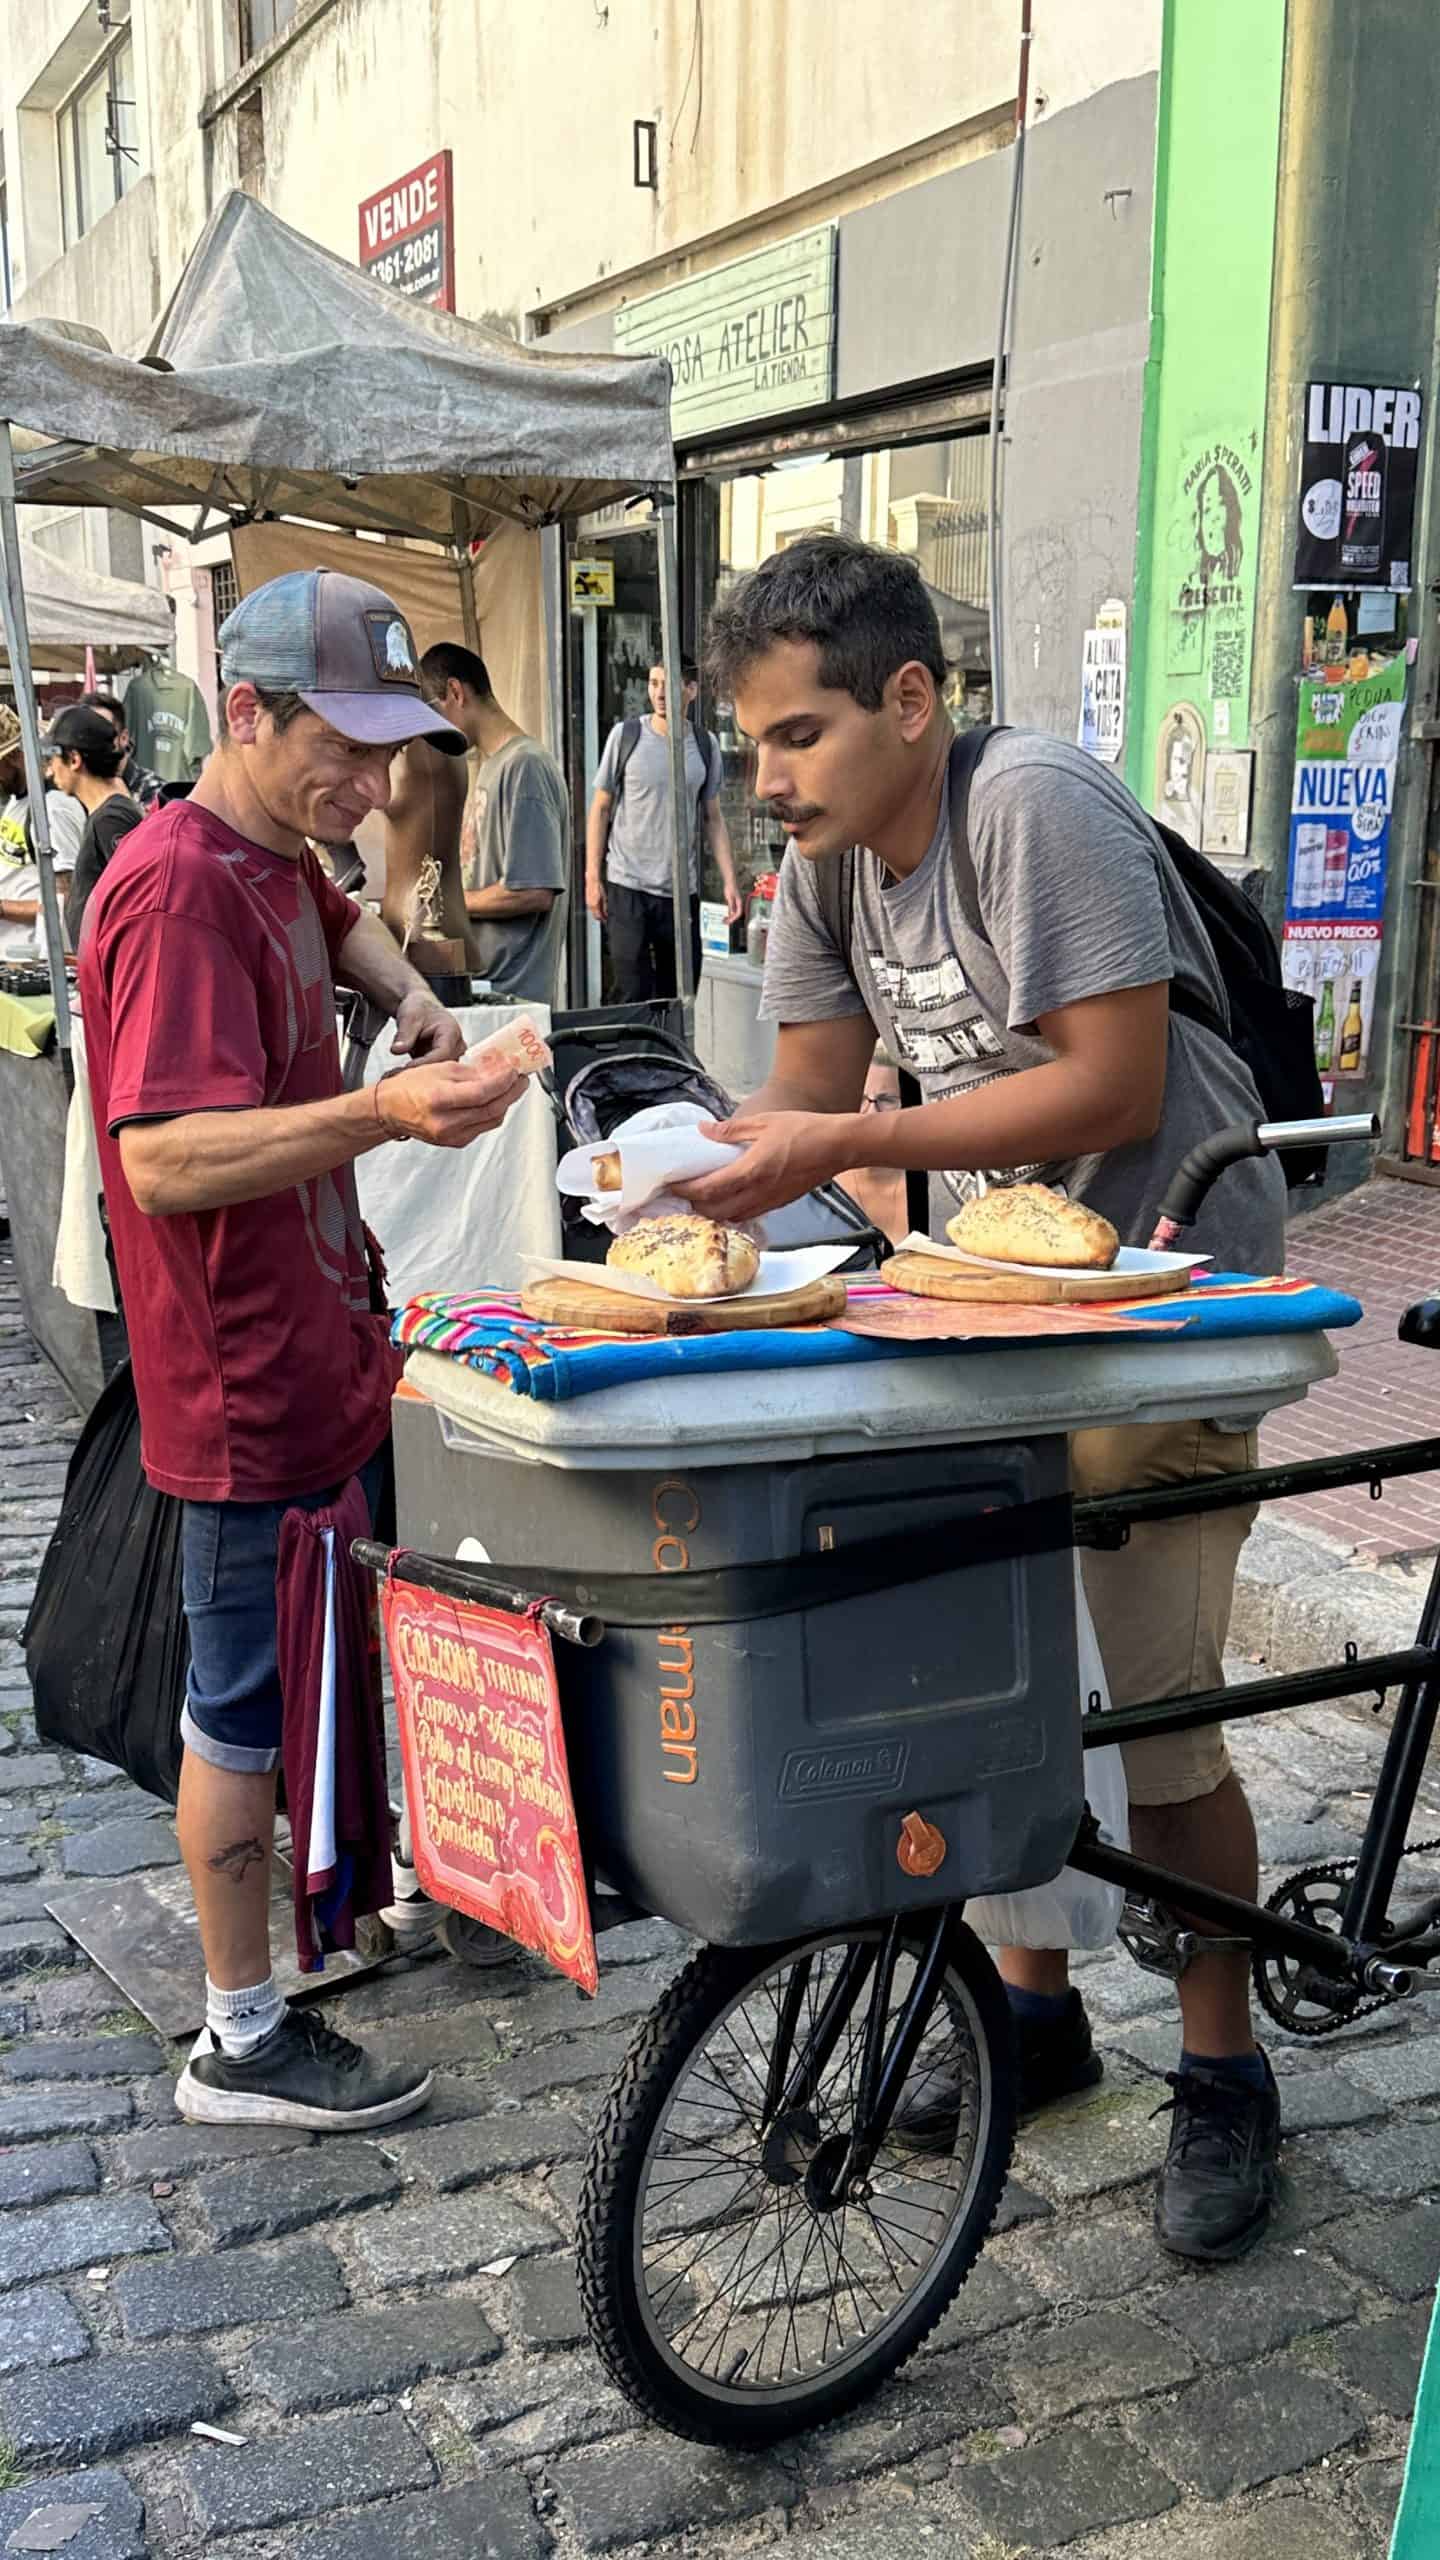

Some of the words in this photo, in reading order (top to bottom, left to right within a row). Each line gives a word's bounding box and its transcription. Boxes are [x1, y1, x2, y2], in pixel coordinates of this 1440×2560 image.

[365, 168, 438, 248] VENDE
[718, 294, 809, 373] ATELIER
[1347, 471, 1381, 499] SPEED
[1298, 768, 1388, 807] NUEVA
[1288, 926, 1332, 939] NUEVO
[1334, 926, 1378, 939] PRECIO
[482, 1657, 548, 1707] ITALIANO
[794, 1757, 873, 1784] Coleman
